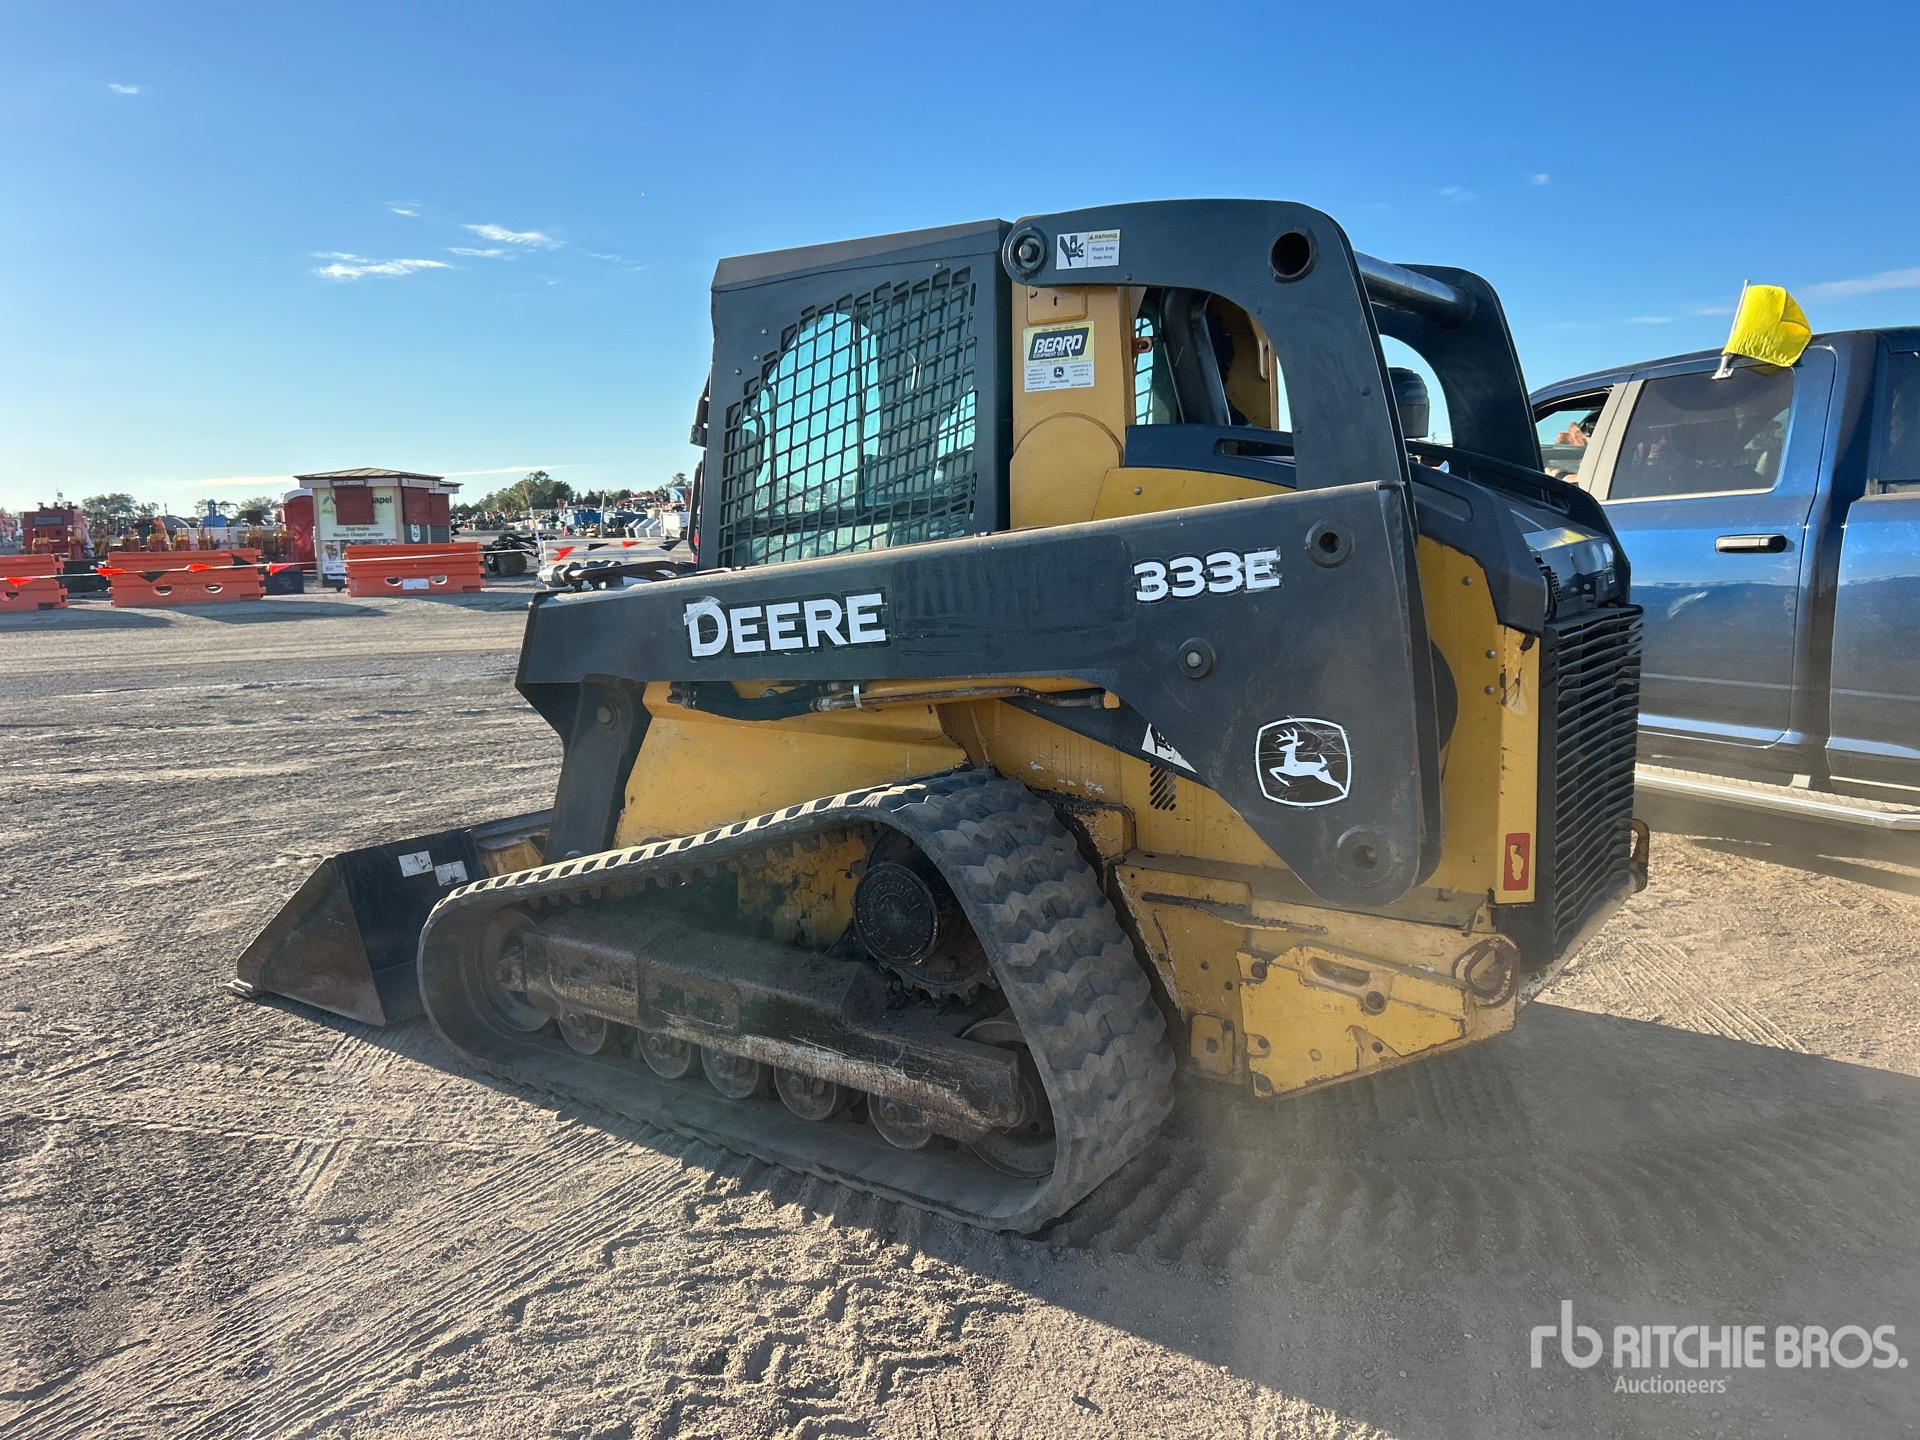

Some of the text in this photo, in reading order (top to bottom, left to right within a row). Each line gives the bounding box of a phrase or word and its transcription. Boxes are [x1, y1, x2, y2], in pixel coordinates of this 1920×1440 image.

[1094, 232, 1117, 240] WARNING
[1034, 334, 1083, 357] BEARD
[1032, 351, 1057, 359] EQUIPMENT
[372, 495, 392, 505] apel
[1134, 548, 1281, 602] 333E
[683, 592, 887, 659] DEERE
